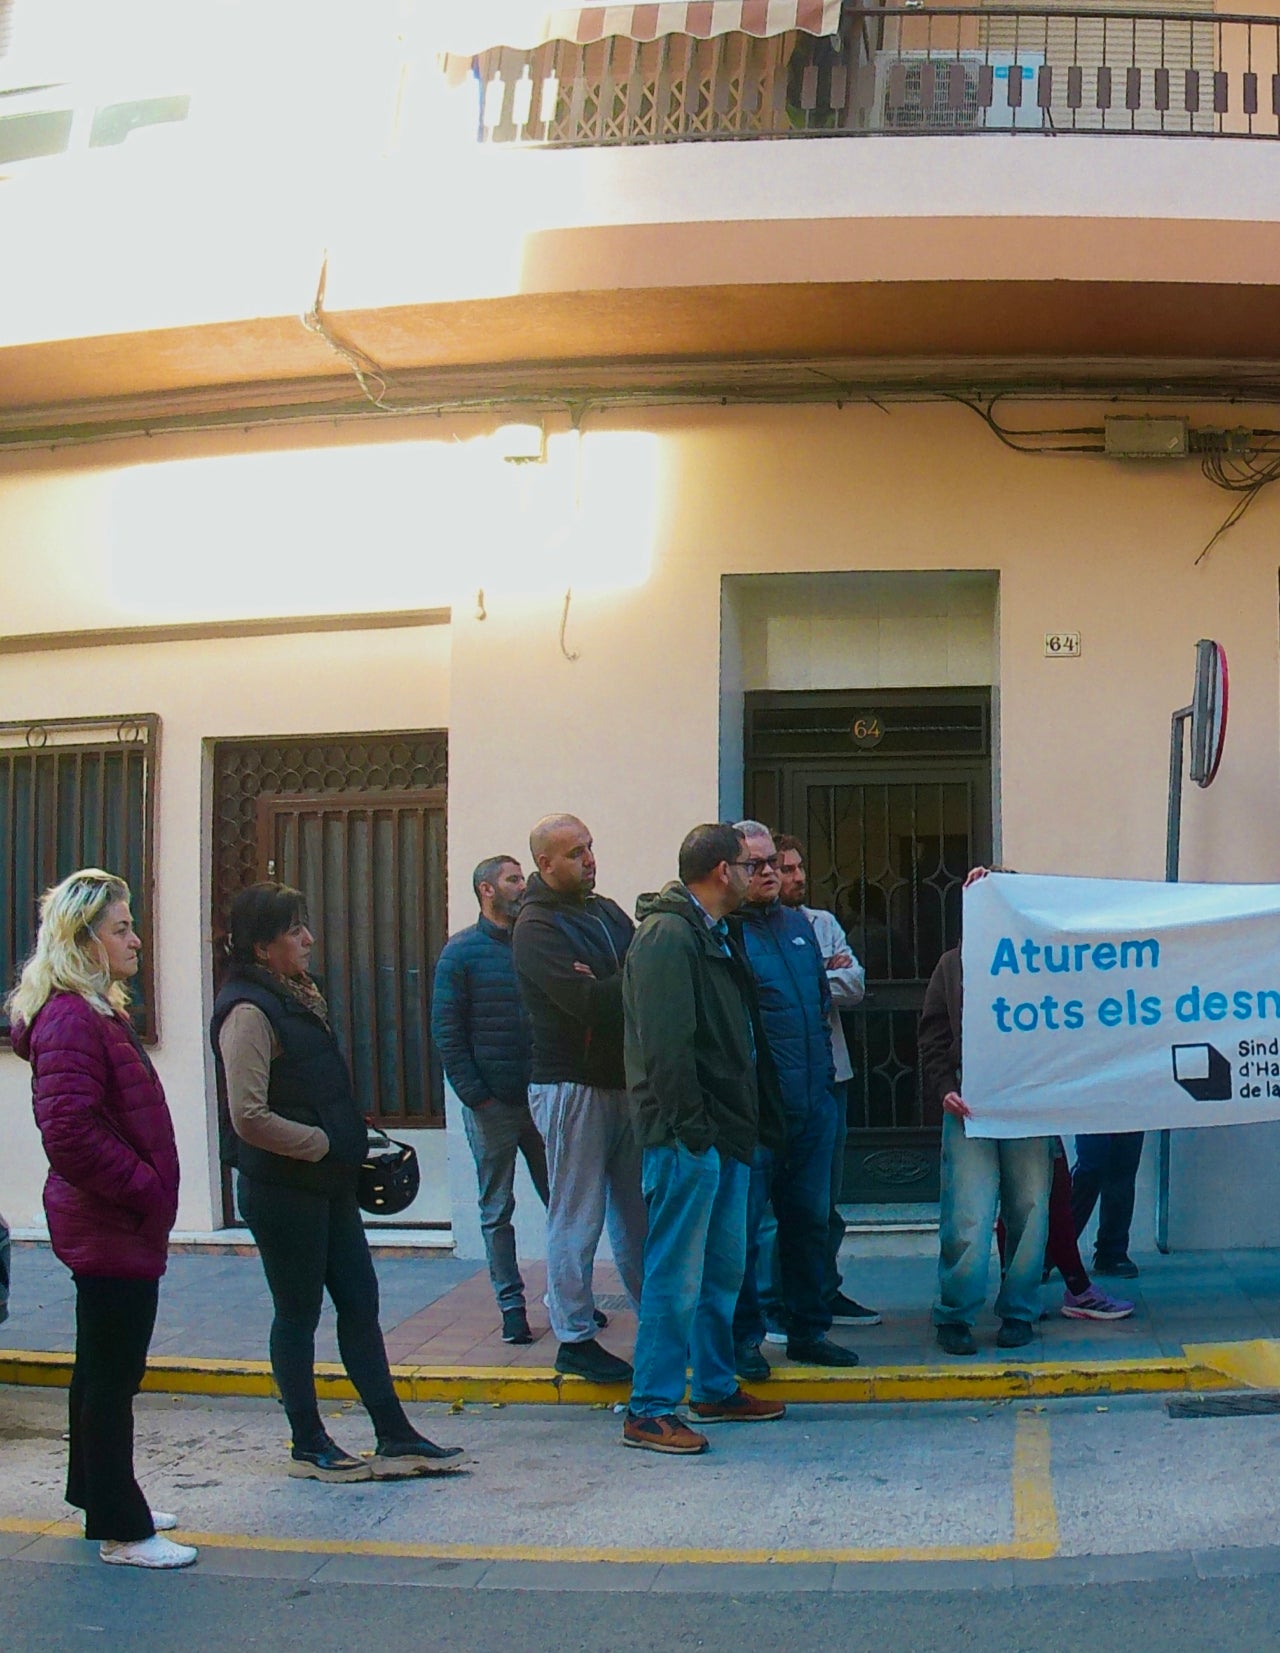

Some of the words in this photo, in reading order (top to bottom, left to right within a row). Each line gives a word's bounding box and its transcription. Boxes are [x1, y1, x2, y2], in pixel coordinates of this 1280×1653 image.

[1049, 635, 1076, 652] 64
[853, 719, 881, 739] 64
[990, 937, 1160, 976] Aturem
[992, 995, 1085, 1033] tots
[1097, 988, 1162, 1027] els
[1239, 1083, 1262, 1099] de
